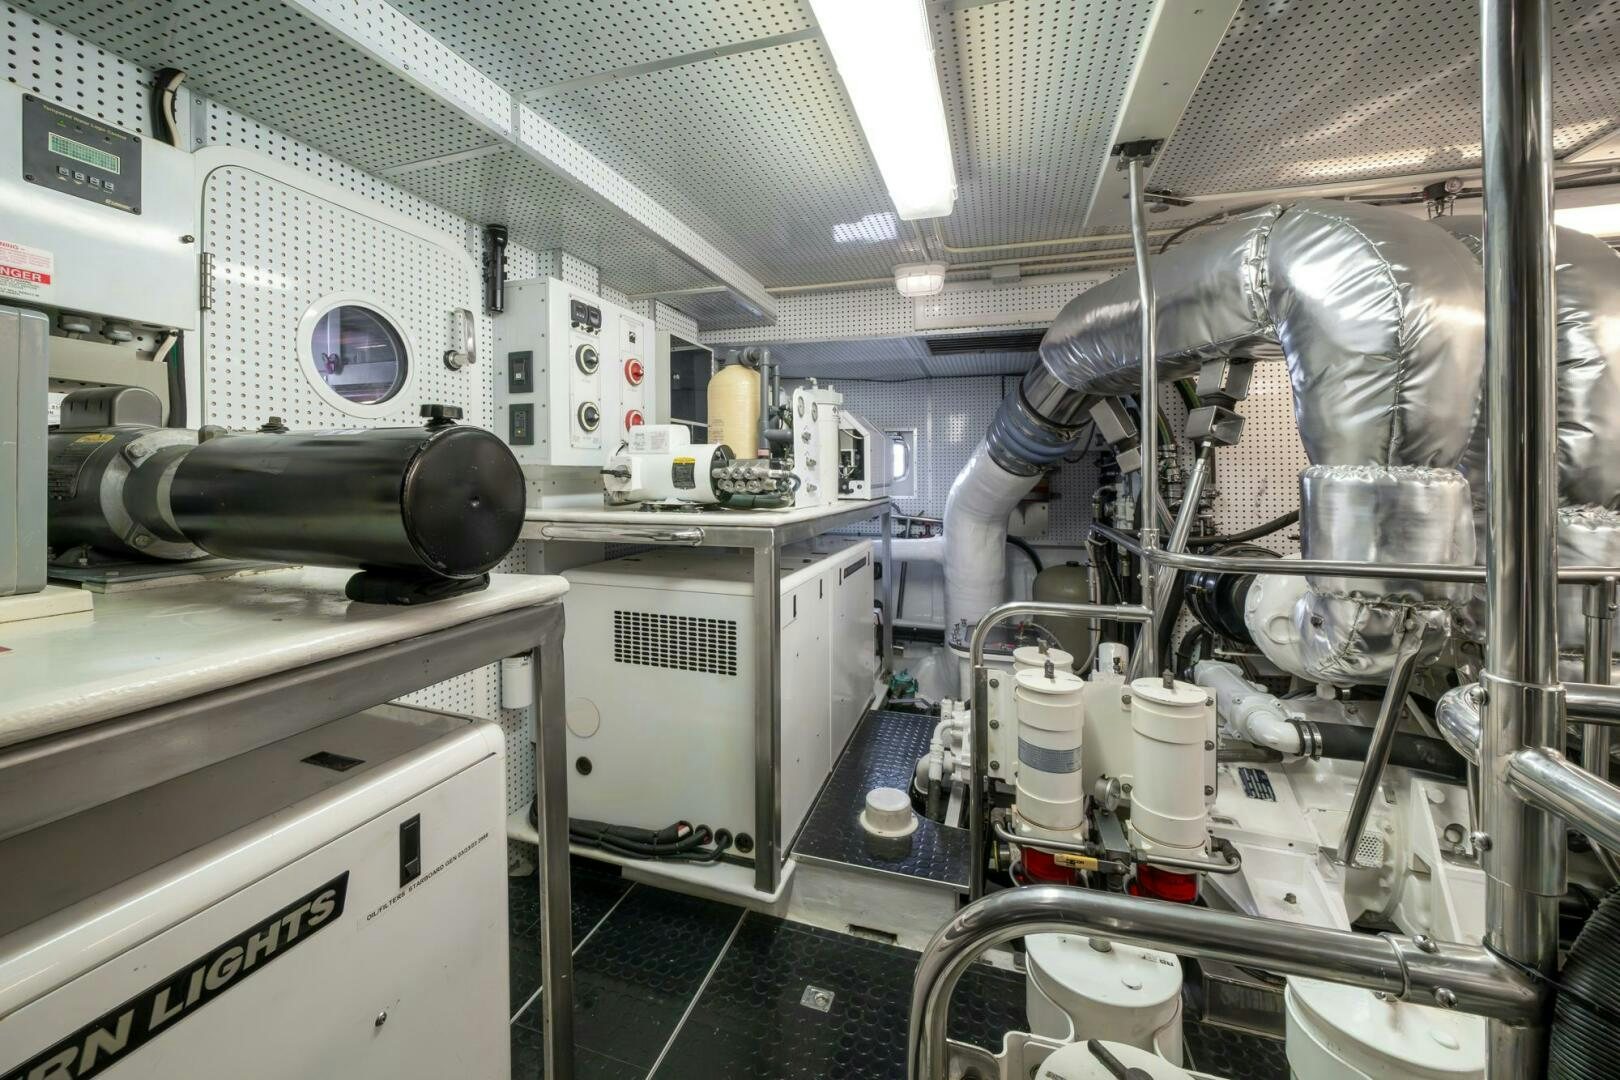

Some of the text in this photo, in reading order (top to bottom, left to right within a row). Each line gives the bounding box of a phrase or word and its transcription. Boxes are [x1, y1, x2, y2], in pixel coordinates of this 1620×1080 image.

[366, 891, 406, 921] OIL/FILTERS
[408, 863, 445, 892] STARBOARD
[445, 855, 458, 867] GEN
[17, 888, 336, 1080] RN LIGHTS
